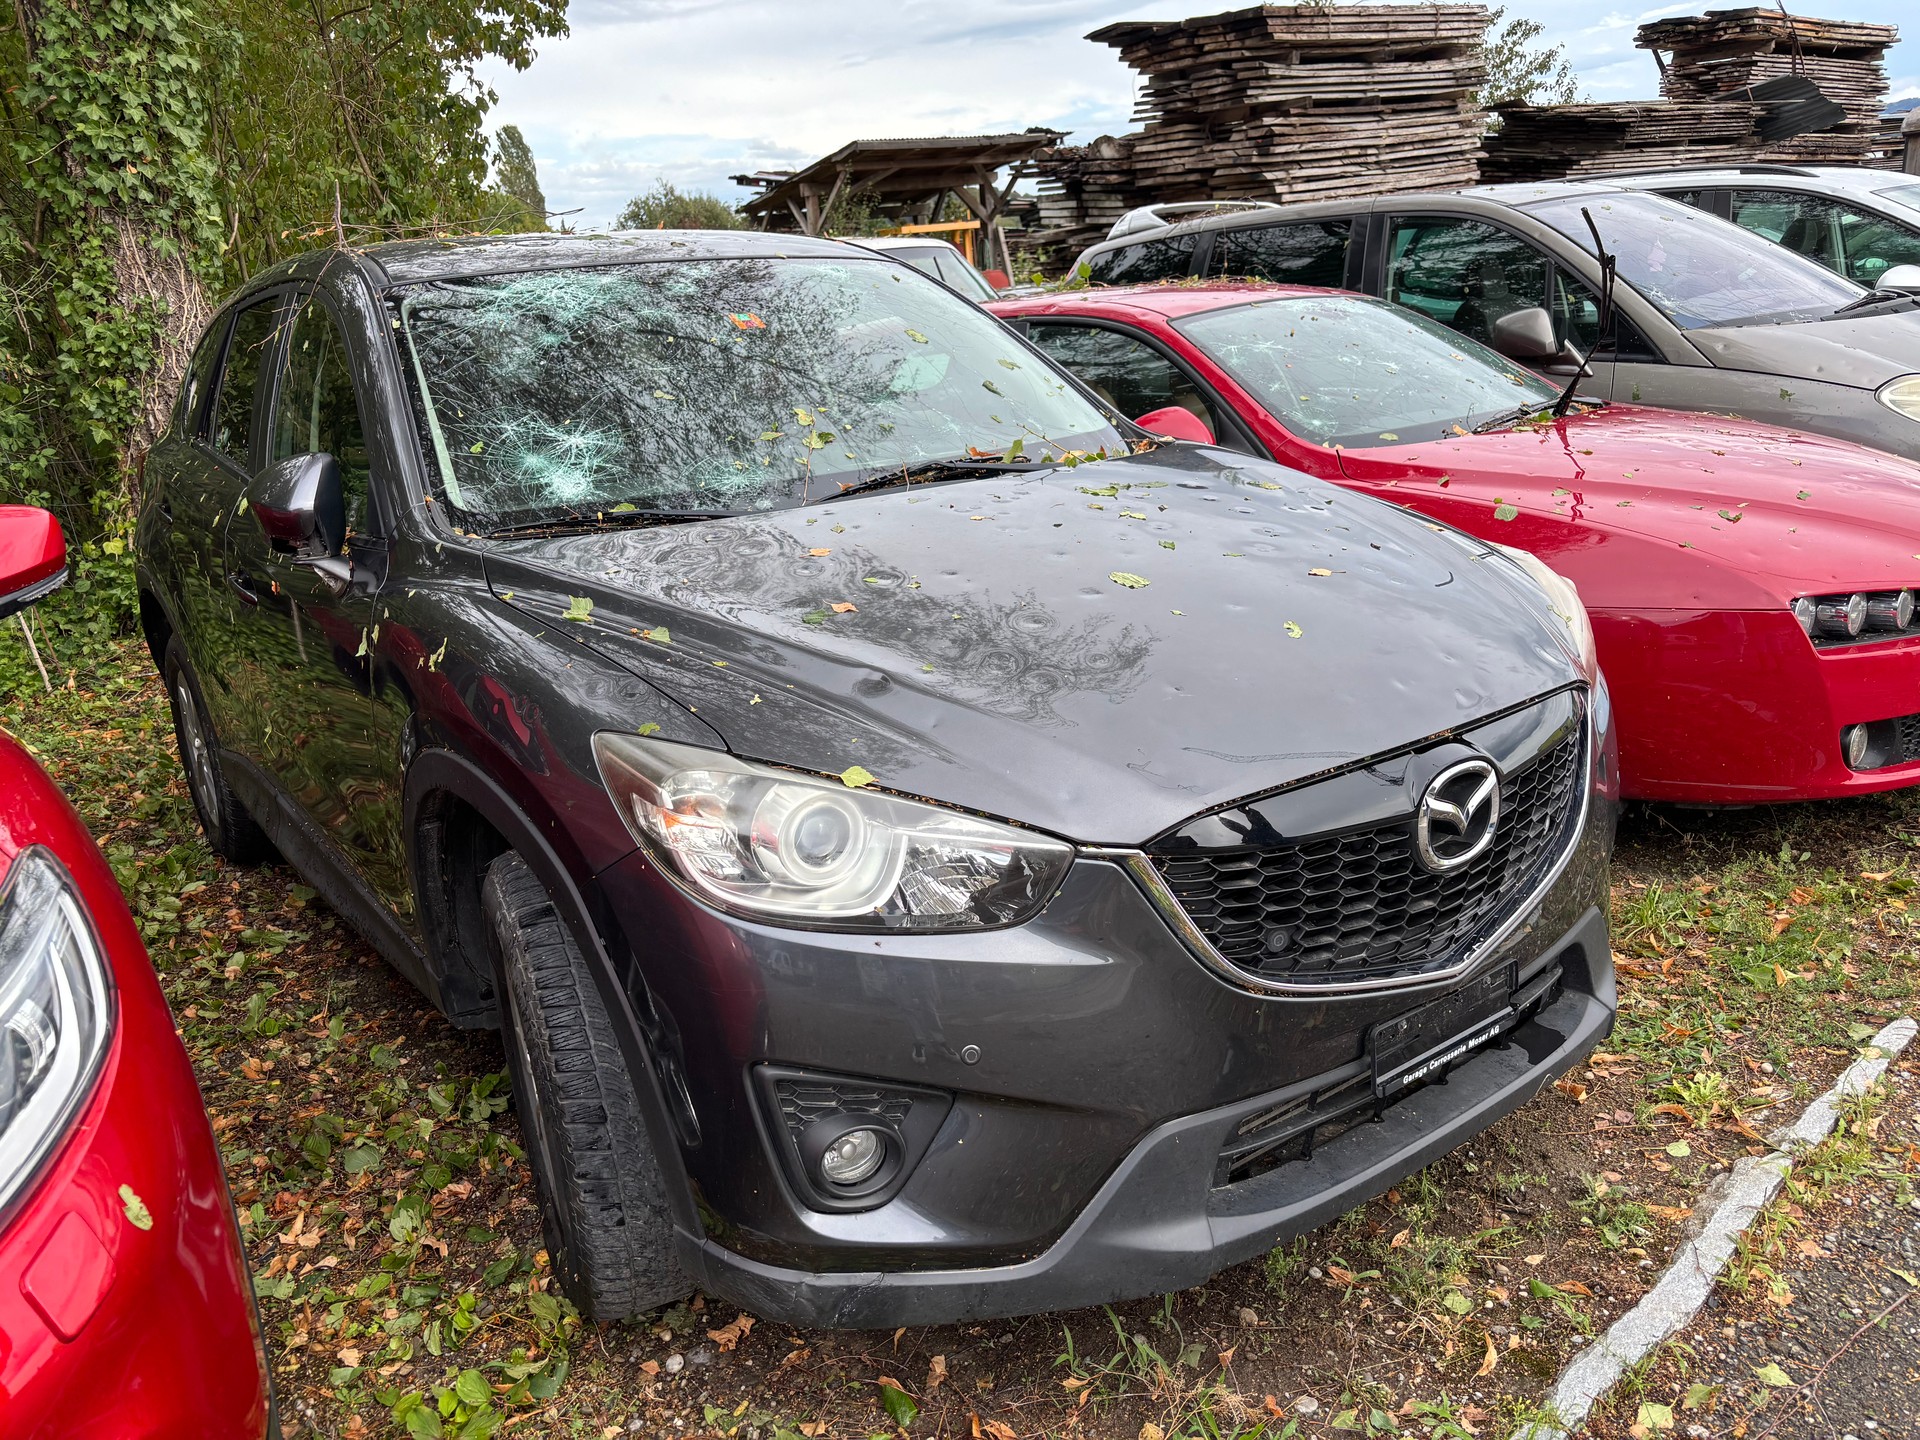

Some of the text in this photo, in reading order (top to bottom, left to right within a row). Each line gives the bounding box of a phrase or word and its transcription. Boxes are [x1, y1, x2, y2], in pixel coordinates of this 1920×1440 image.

[1403, 1025, 1500, 1084] Garage Carrosserie Moser AG
